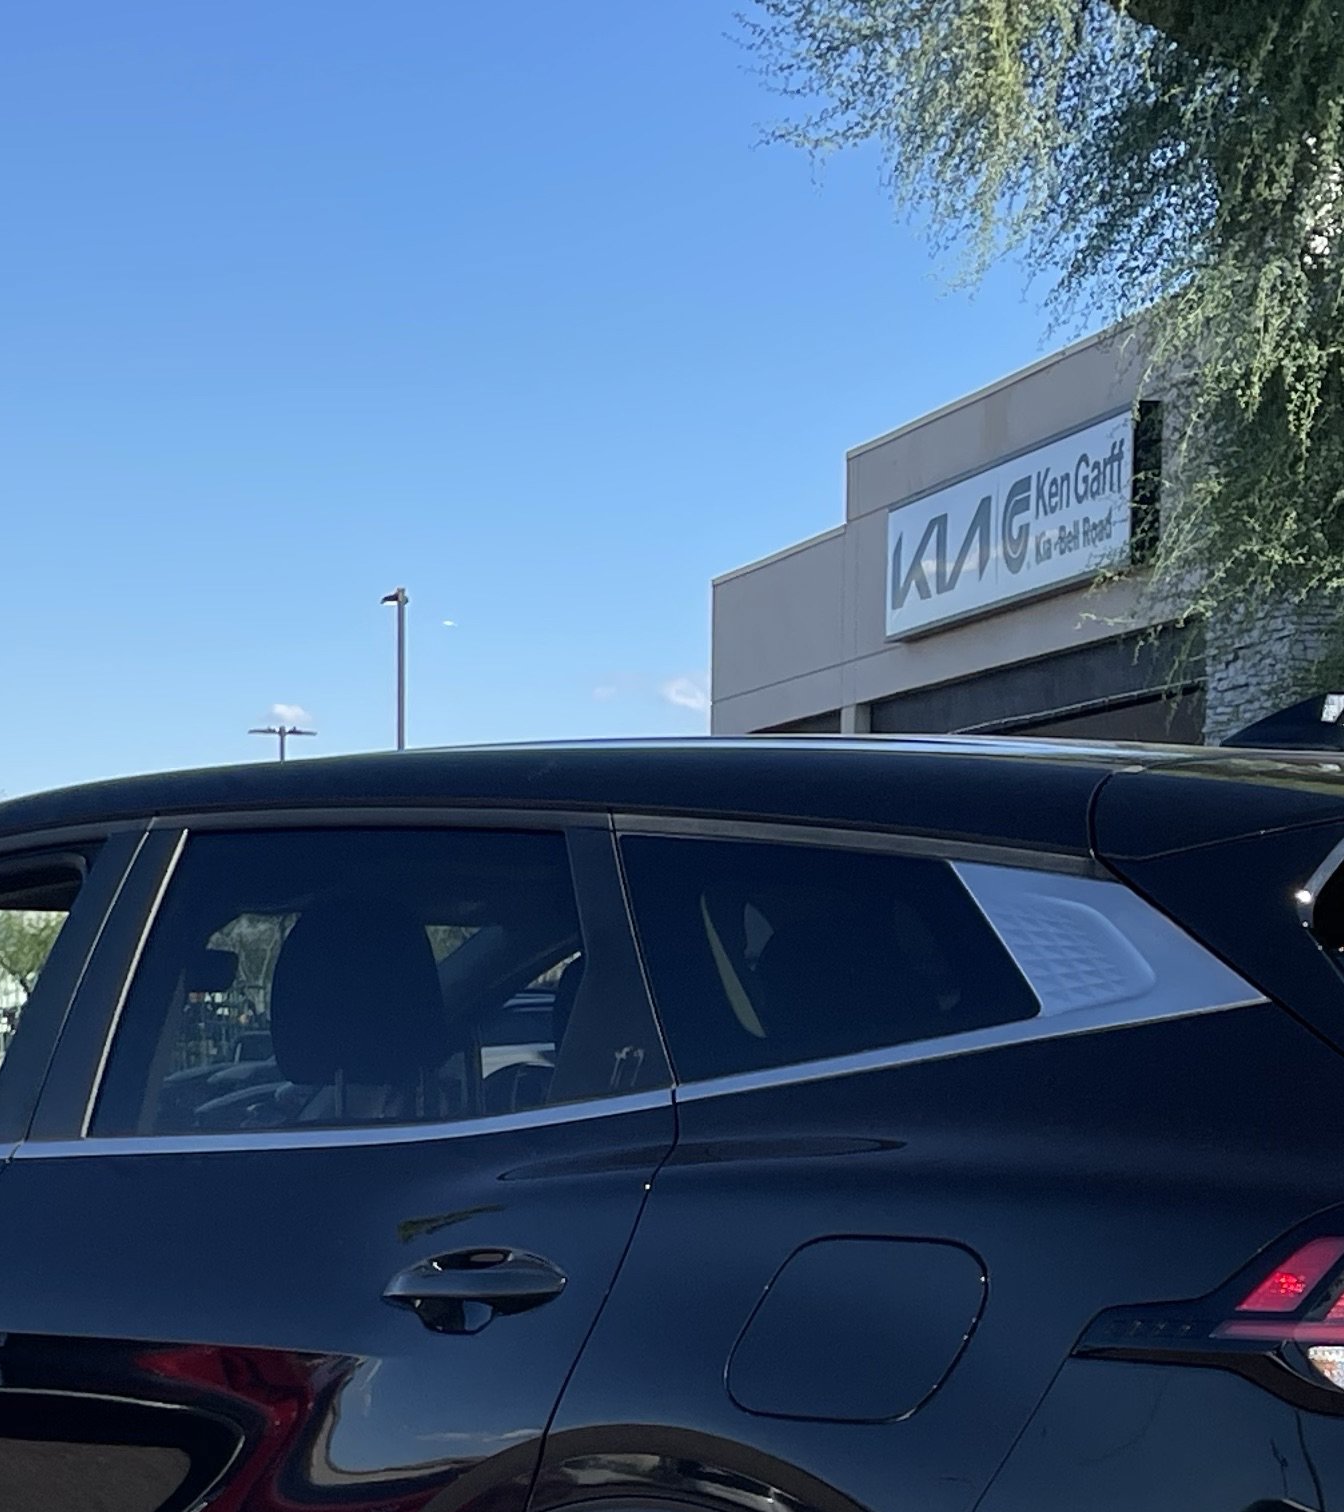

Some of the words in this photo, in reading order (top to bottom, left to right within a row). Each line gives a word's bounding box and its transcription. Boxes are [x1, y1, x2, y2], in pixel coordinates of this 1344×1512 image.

[1035, 467, 1071, 520] Ken
[1074, 438, 1125, 505] Garff
[891, 494, 992, 610] KIA
